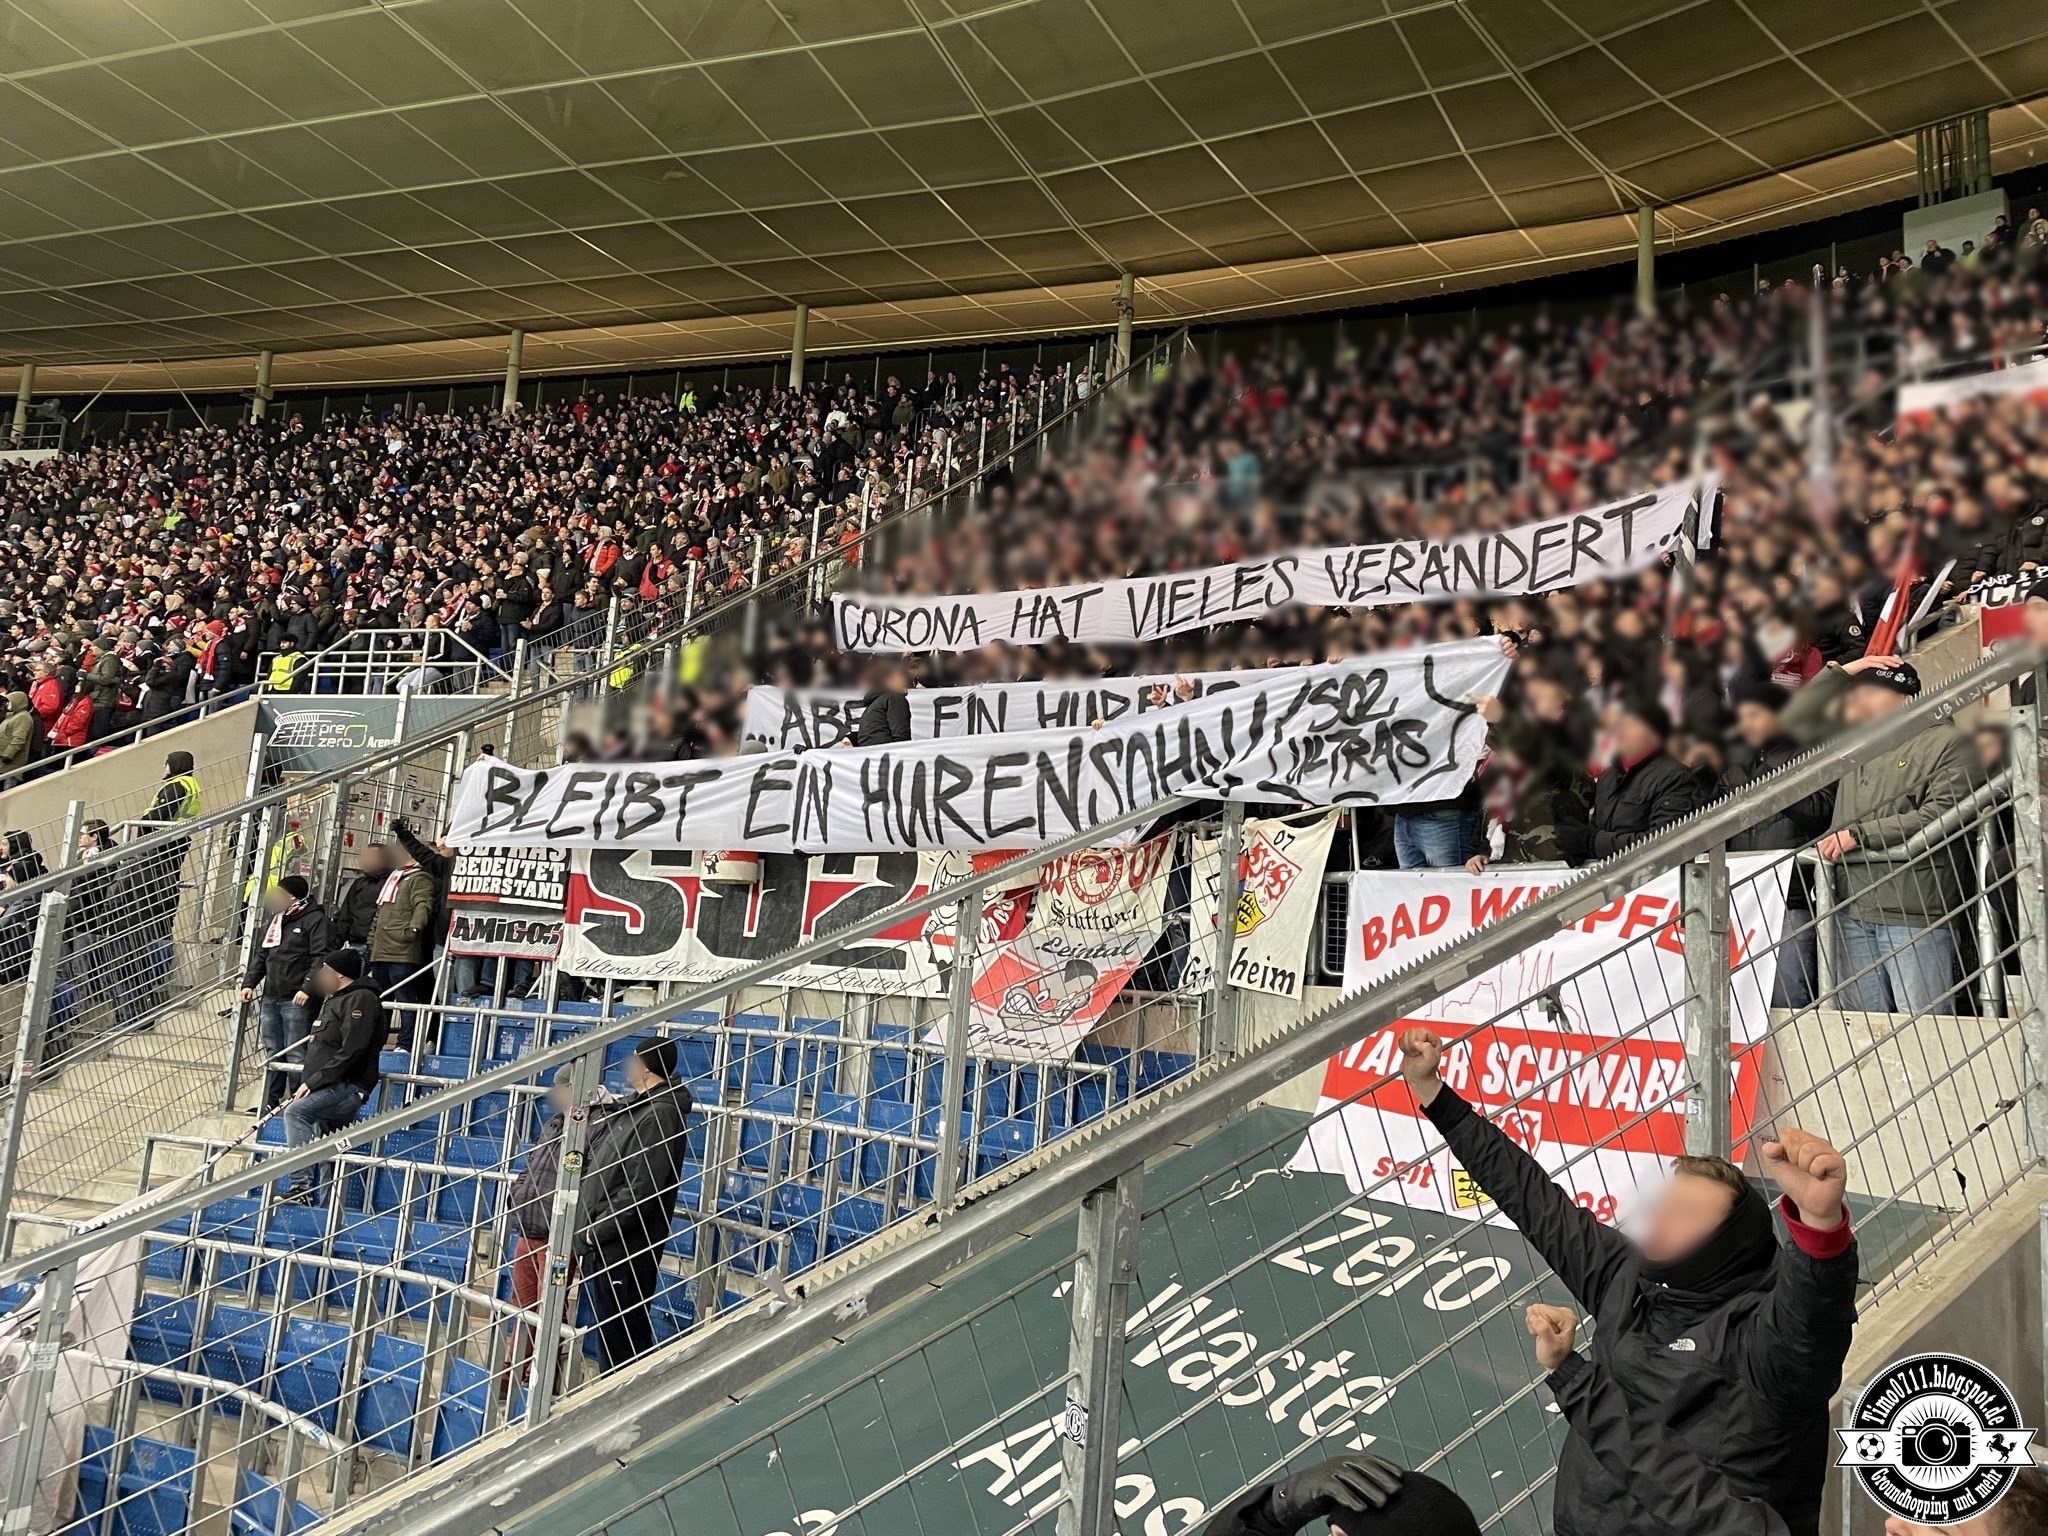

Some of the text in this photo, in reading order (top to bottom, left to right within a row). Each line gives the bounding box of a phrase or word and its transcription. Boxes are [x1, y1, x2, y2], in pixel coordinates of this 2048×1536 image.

[839, 597, 987, 650] CORONA
[1010, 586, 1103, 638] HAT
[1127, 554, 1299, 639] VIELES
[318, 736, 353, 748] zero
[319, 723, 345, 737] pre
[1286, 718, 1431, 789] ULTRAS
[470, 765, 722, 841] BLEIBT
[743, 759, 832, 845] EIN
[452, 856, 566, 882] BEDEUTET
[450, 875, 564, 901] WIDERSTAND
[1362, 895, 1451, 961] BAD
[575, 957, 640, 976] Ultras
[1372, 1156, 1437, 1189] seit
[1270, 1206, 1512, 1311] Zero
